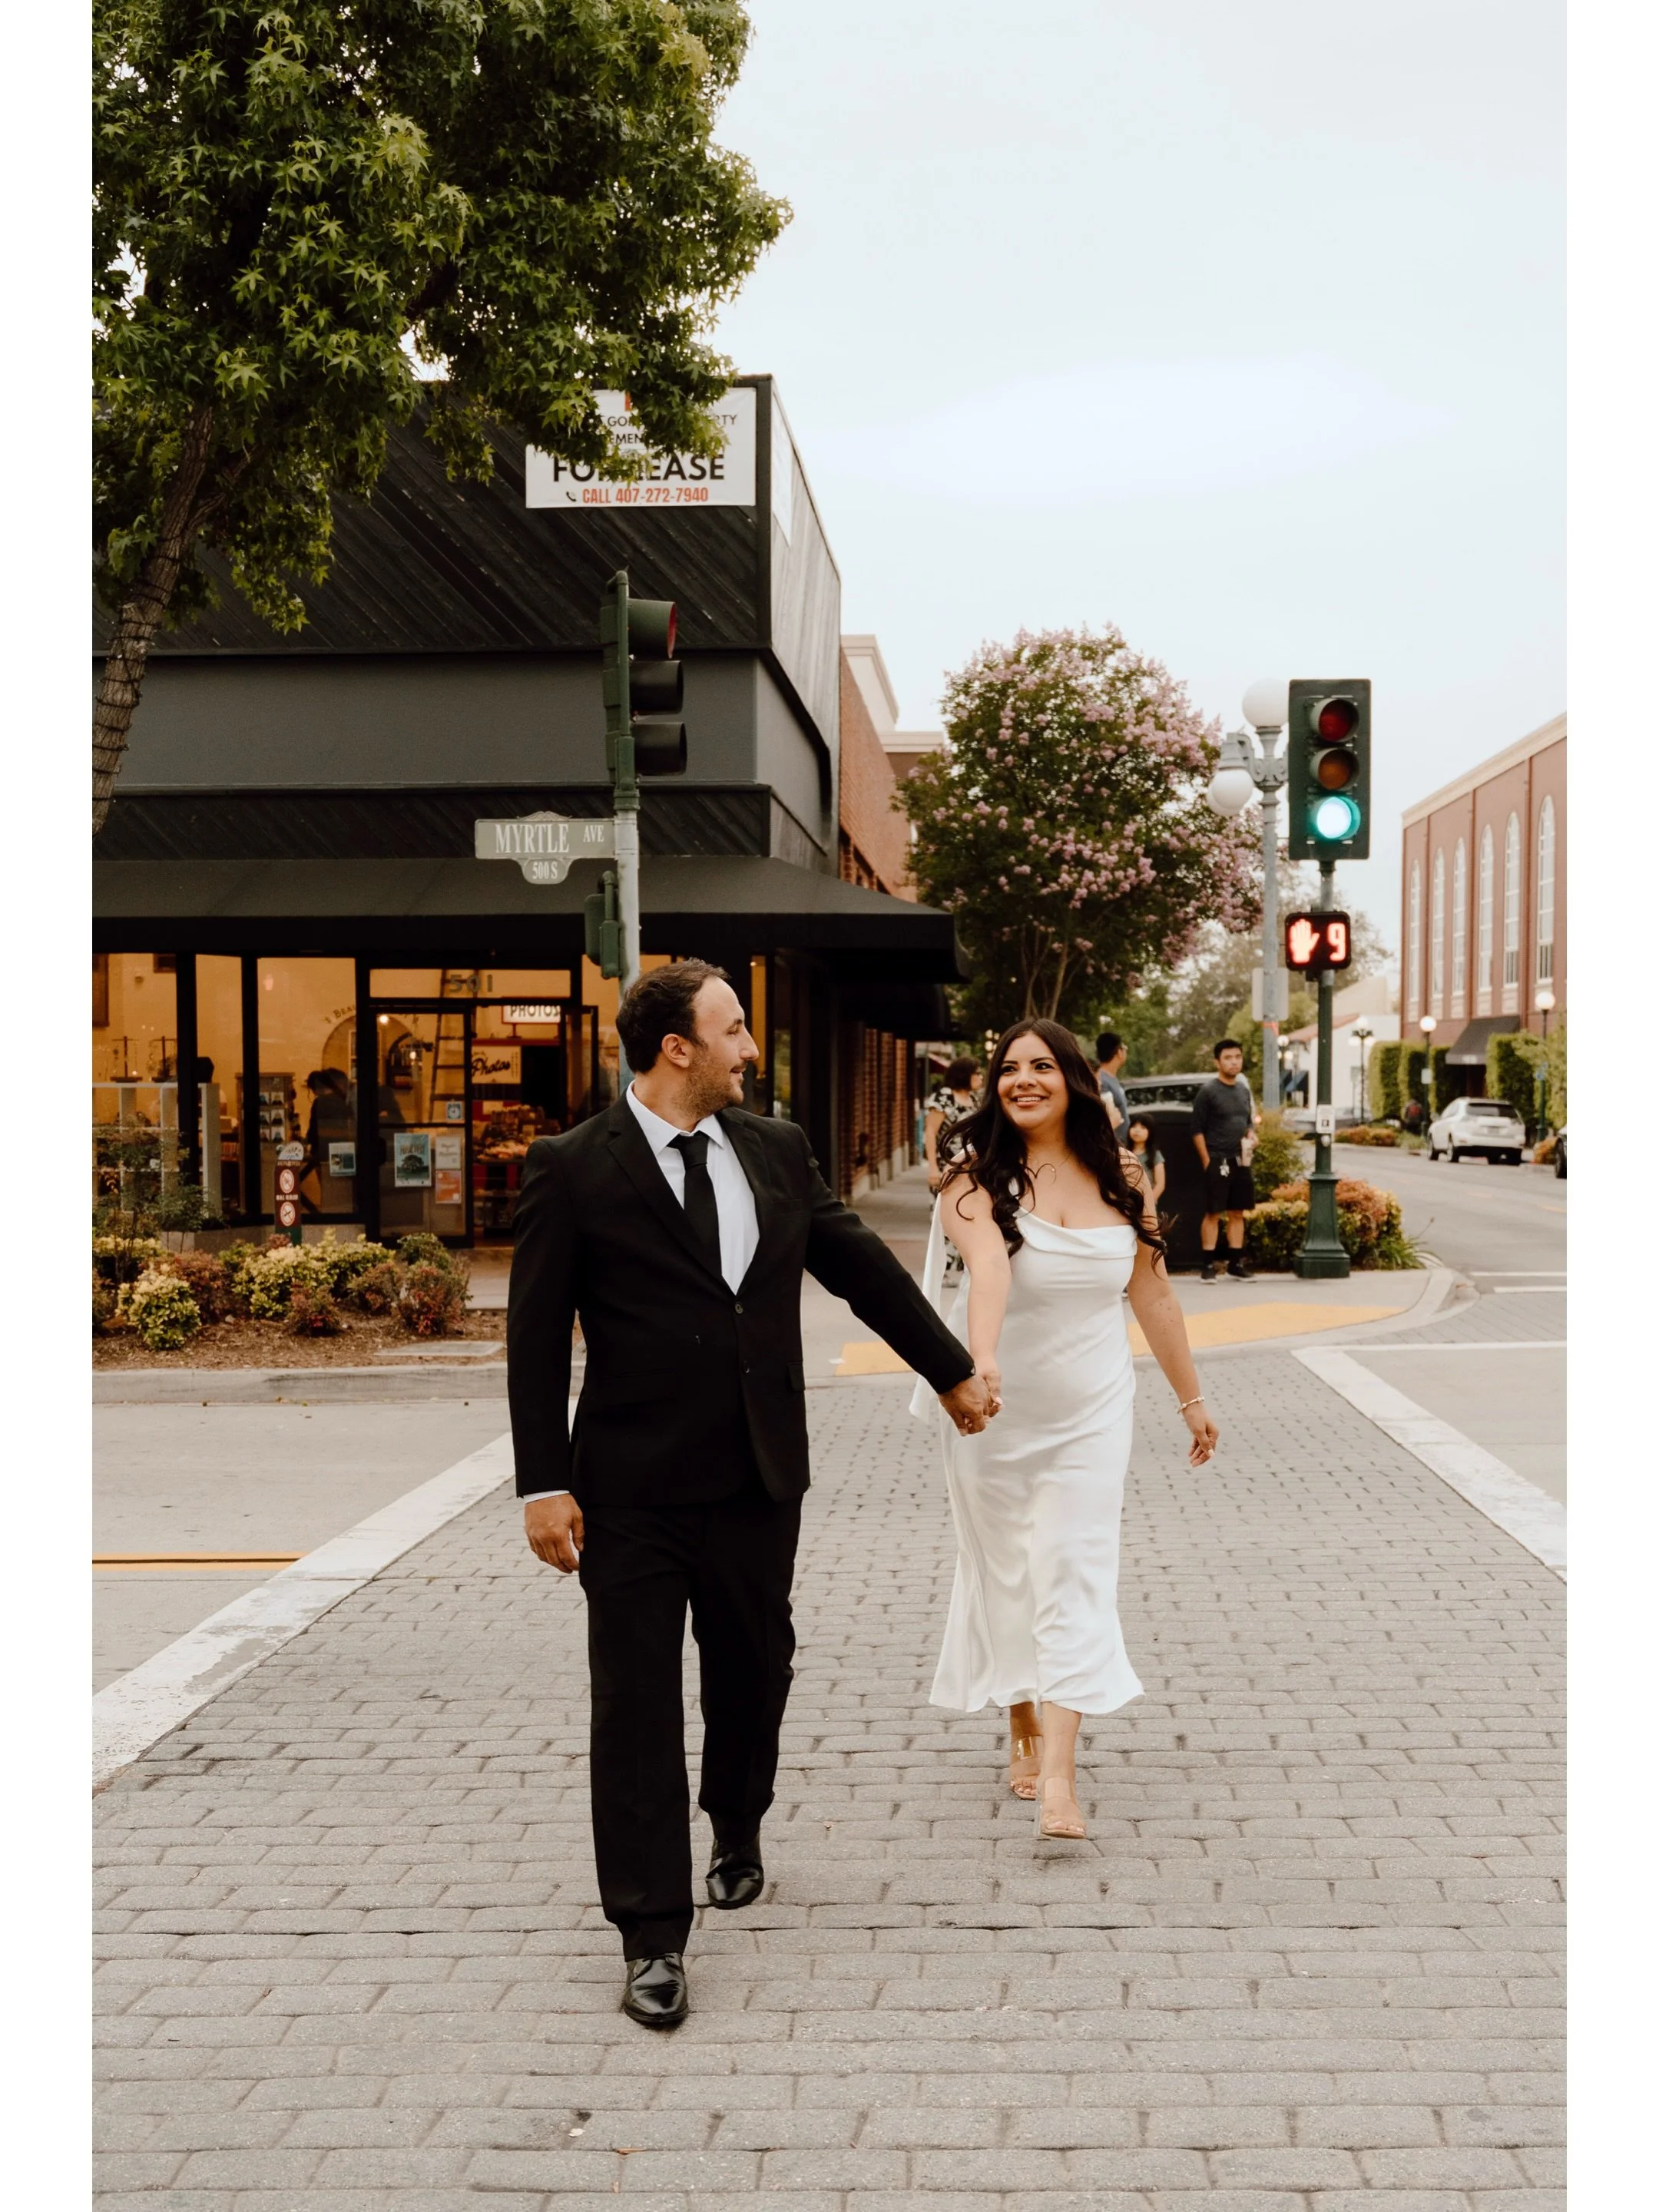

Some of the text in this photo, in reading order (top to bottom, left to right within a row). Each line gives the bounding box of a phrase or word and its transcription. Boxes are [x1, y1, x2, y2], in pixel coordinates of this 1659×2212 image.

[582, 487, 708, 504] CALL 407-272-7940
[495, 823, 604, 853] MYRTLE AVE
[532, 861, 558, 879] 500 S
[1328, 922, 1346, 961] 9
[449, 974, 493, 992] 501
